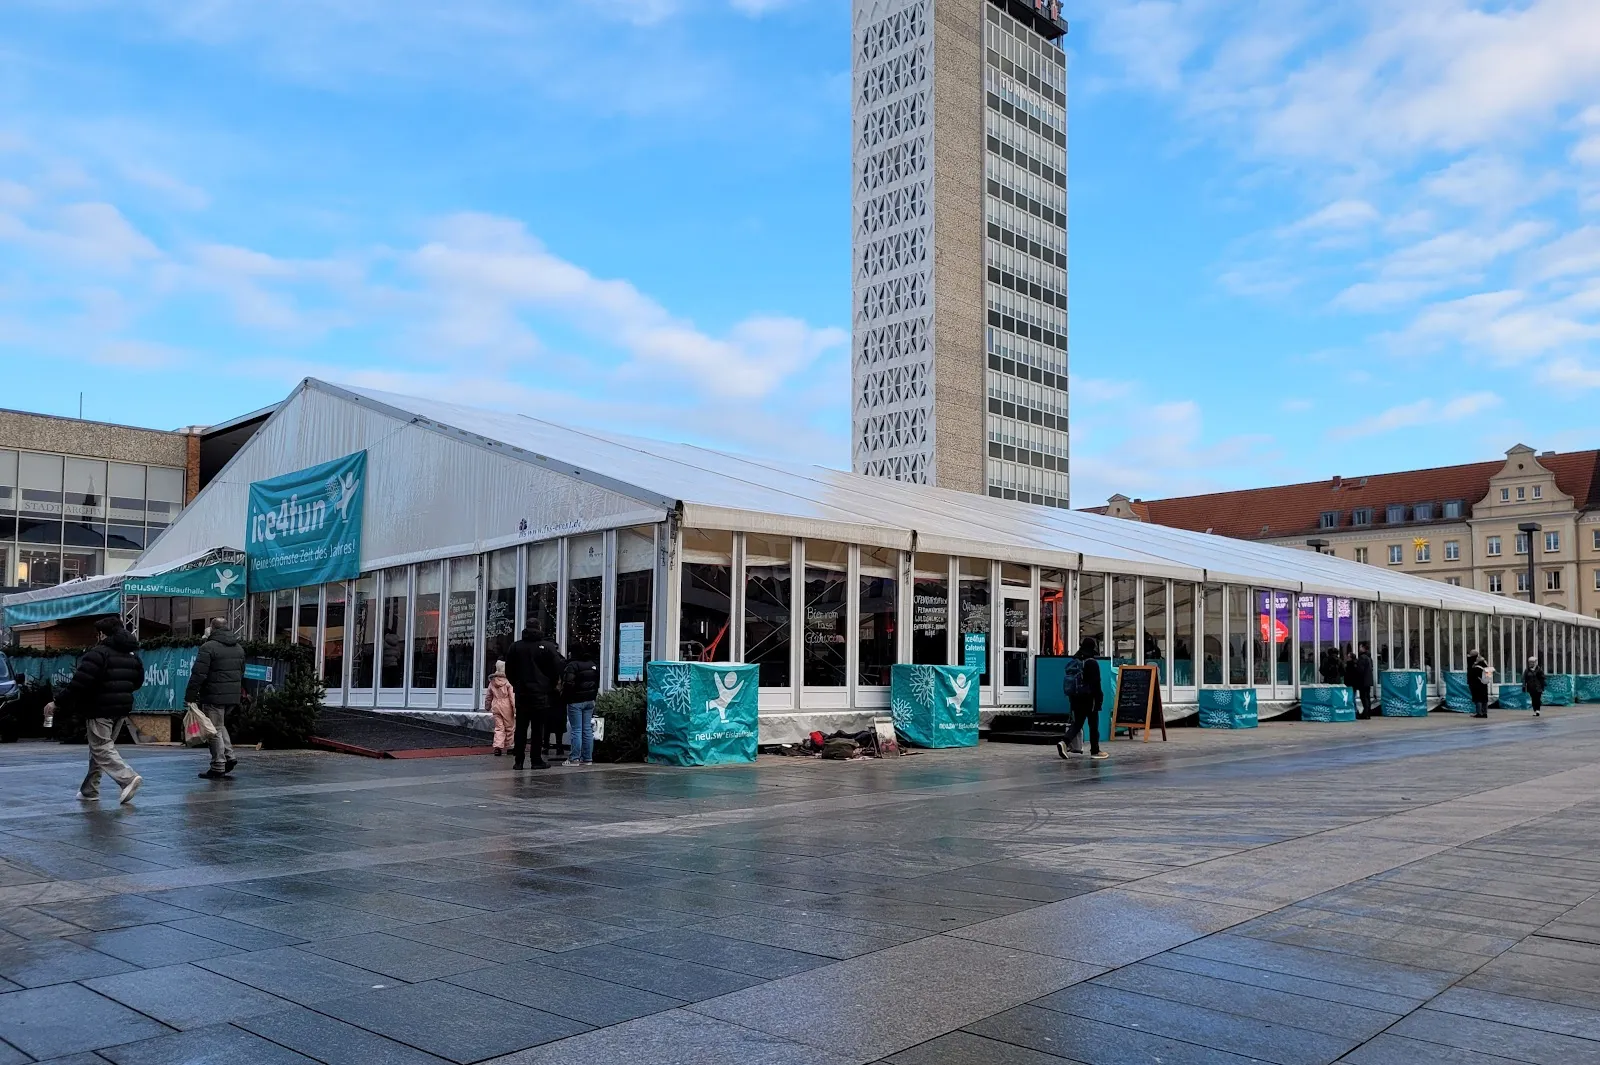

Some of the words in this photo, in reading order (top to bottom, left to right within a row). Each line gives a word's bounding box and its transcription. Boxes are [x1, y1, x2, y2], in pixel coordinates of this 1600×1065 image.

[251, 493, 326, 544] ice4fun
[251, 557, 268, 571] Meine
[268, 551, 299, 567] schönste
[300, 548, 313, 563] Zeit
[314, 546, 328, 559] des
[329, 538, 356, 557] Jahres!
[164, 585, 205, 595] Eislaufhalle
[964, 634, 986, 643] ice4fun
[964, 644, 986, 652] Cafeteria
[141, 663, 169, 687] e4fun
